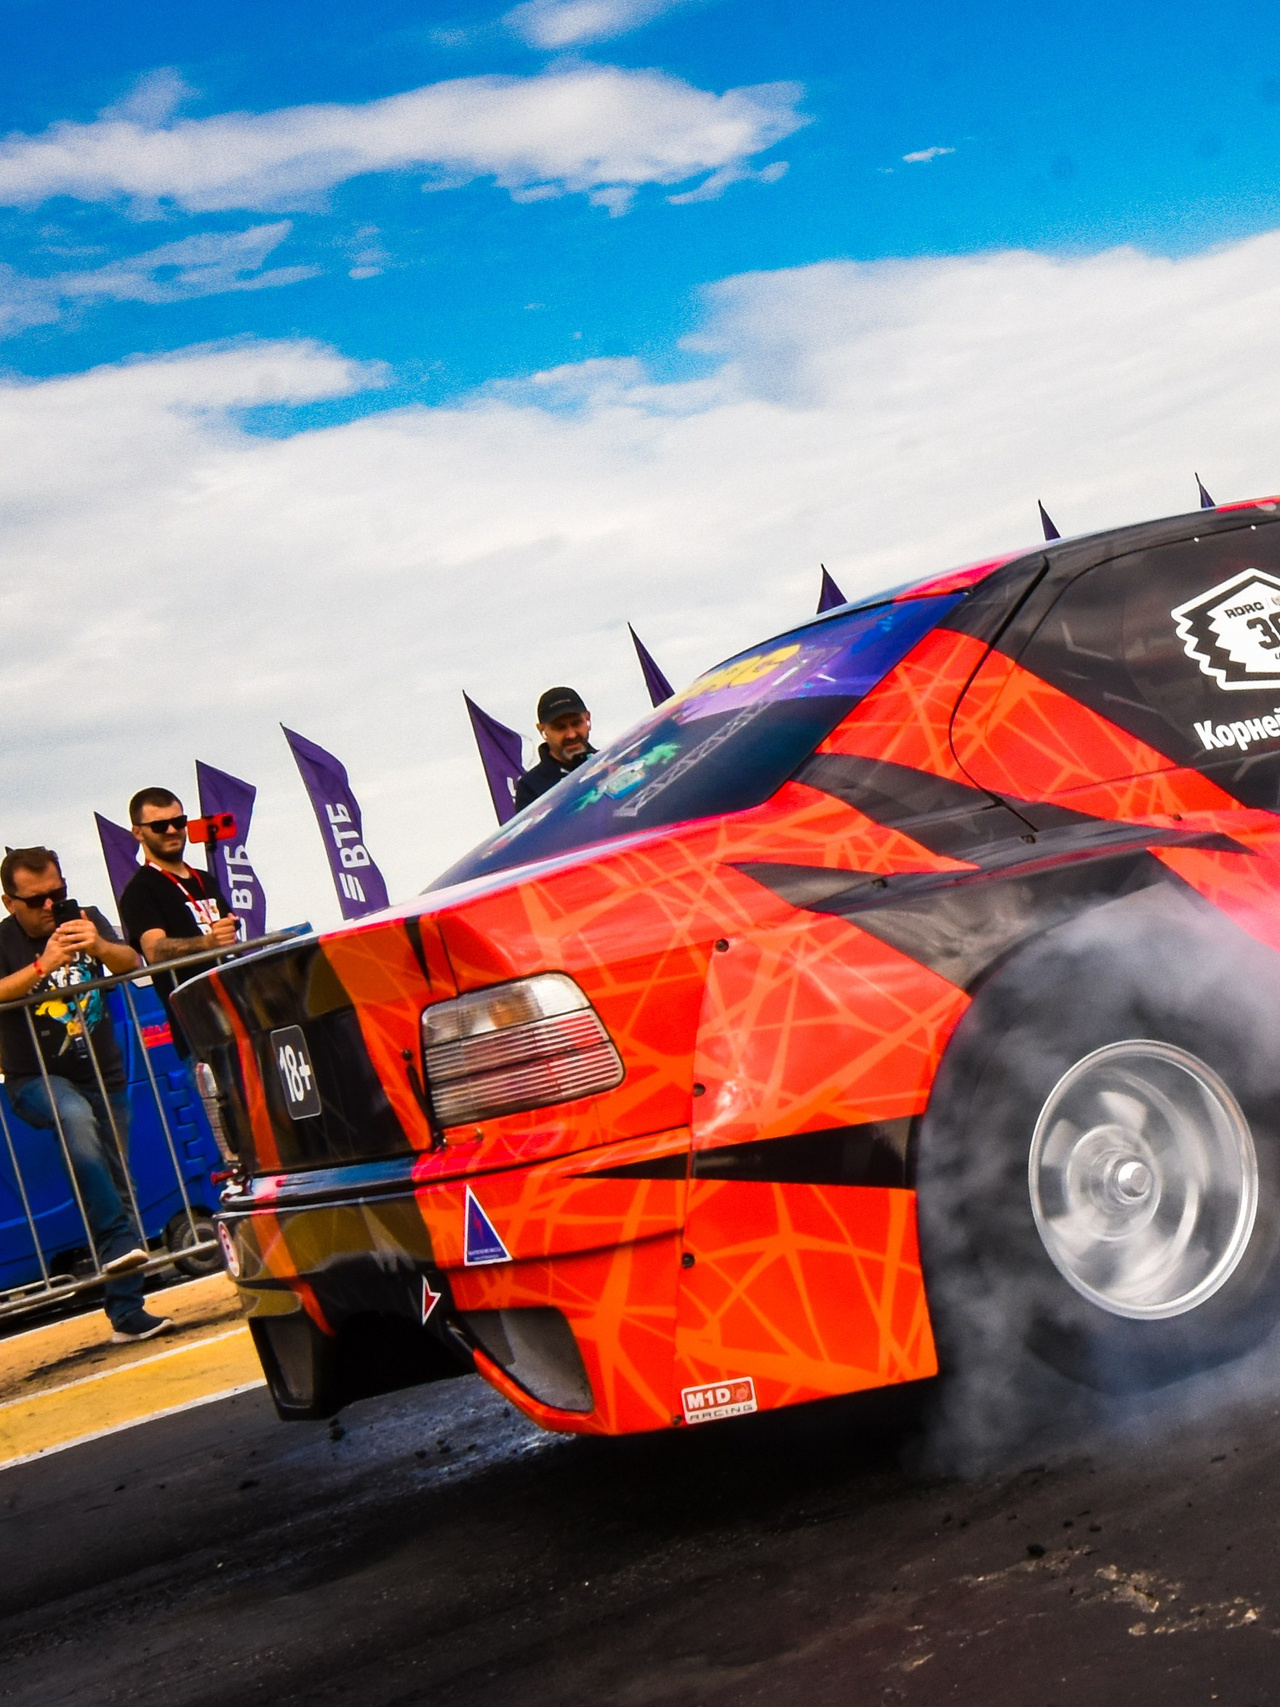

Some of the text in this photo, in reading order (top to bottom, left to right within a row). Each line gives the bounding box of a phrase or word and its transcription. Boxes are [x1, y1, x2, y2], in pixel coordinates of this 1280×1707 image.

[1224, 601, 1265, 619] RDRC
[325, 802, 371, 869] ВТБ
[224, 844, 254, 910] ВТБ
[279, 1044, 311, 1102] 18+
[686, 1387, 731, 1409] M1D
[690, 1403, 753, 1421] RACING
